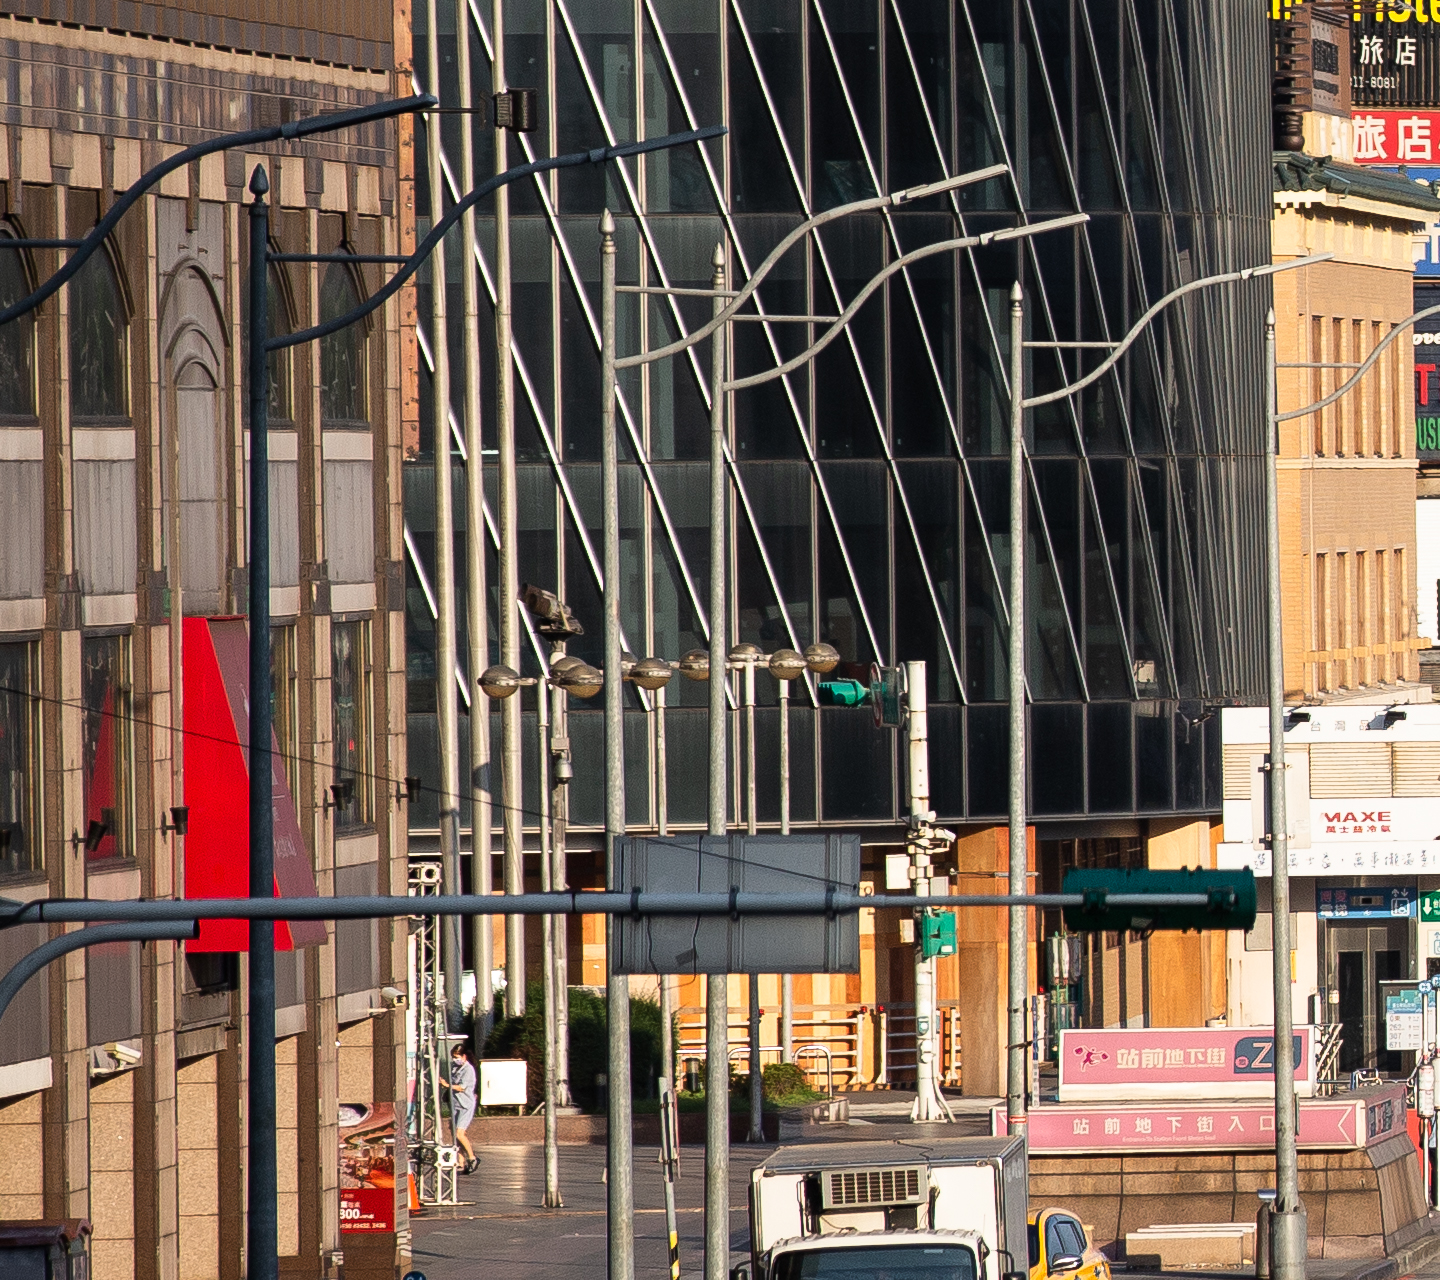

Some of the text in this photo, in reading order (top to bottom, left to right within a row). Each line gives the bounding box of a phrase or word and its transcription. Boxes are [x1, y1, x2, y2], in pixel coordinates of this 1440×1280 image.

[1360, 35, 1417, 66] 旅店
[1350, 76, 1396, 89] 11-8081
[1116, 1047, 1226, 1069] 站前地下街
[1073, 1116, 1275, 1134] 站前地下街入口
